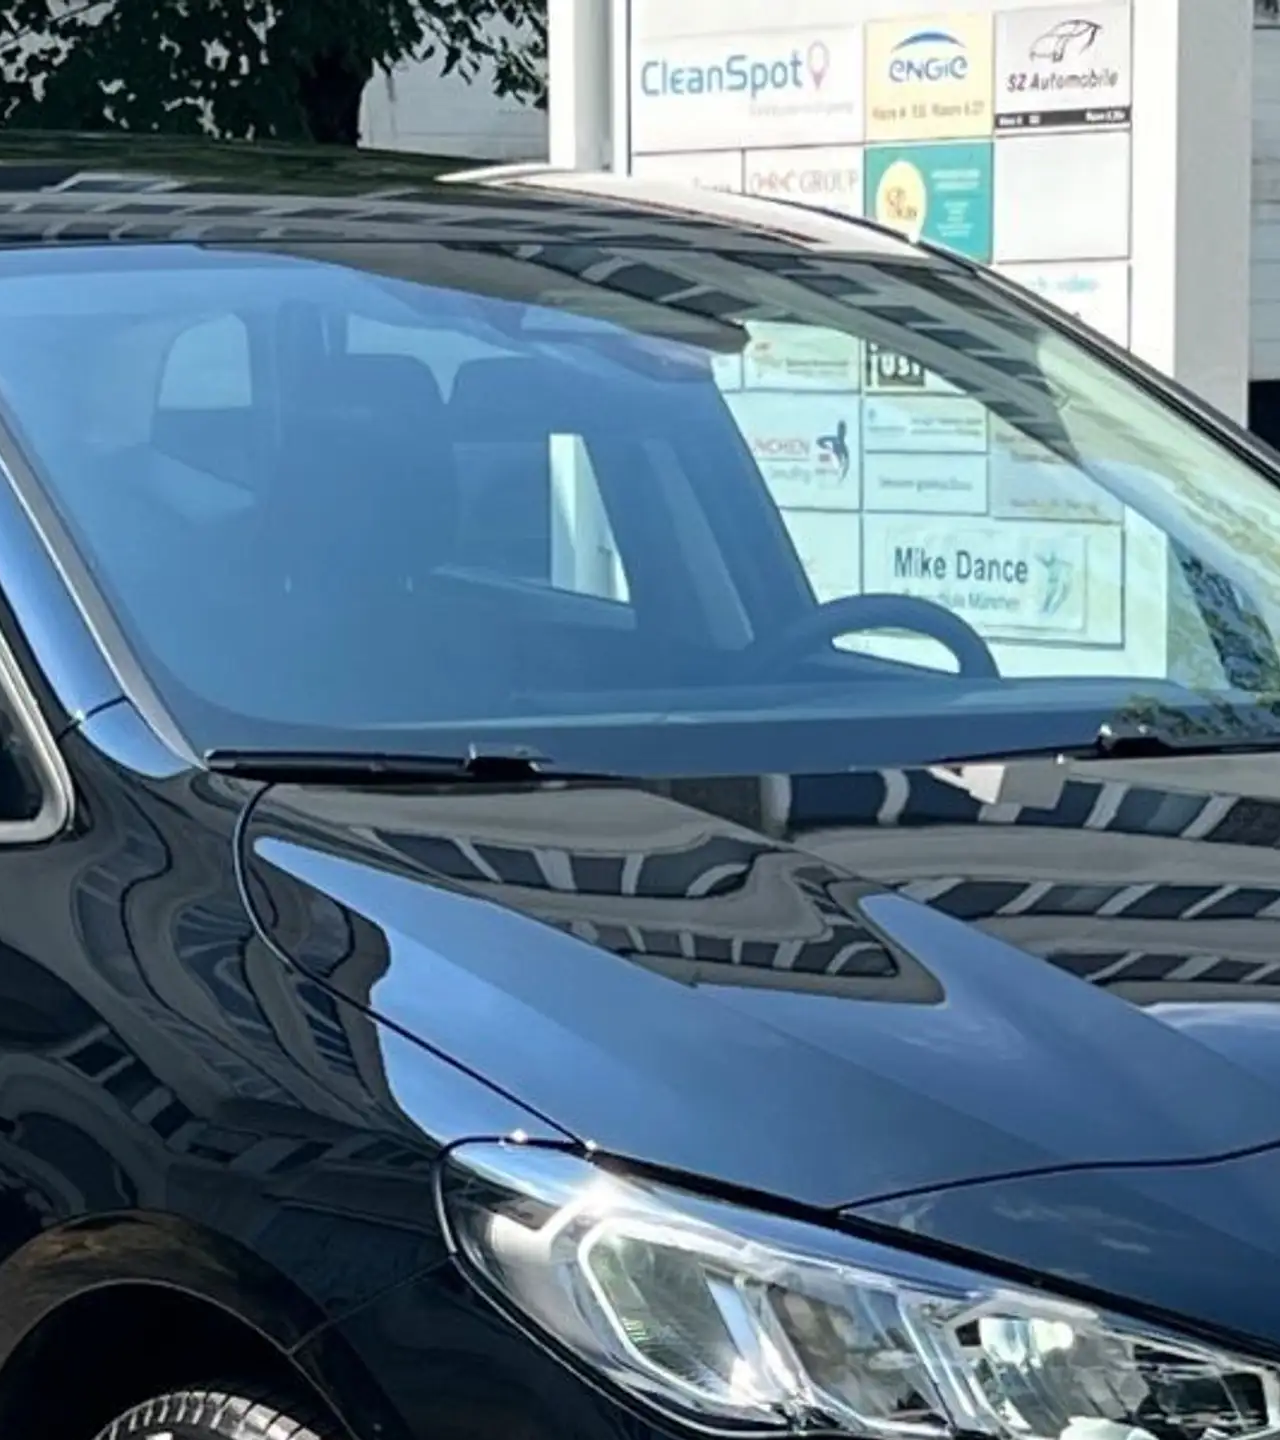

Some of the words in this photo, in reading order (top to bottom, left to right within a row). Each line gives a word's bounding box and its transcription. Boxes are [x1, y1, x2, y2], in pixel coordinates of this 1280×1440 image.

[640, 50, 803, 101] CleanSpot
[1006, 73, 1027, 93] SZ
[1030, 67, 1119, 91] Automobile
[894, 546, 947, 580] Mike
[956, 549, 1029, 585] Dance
